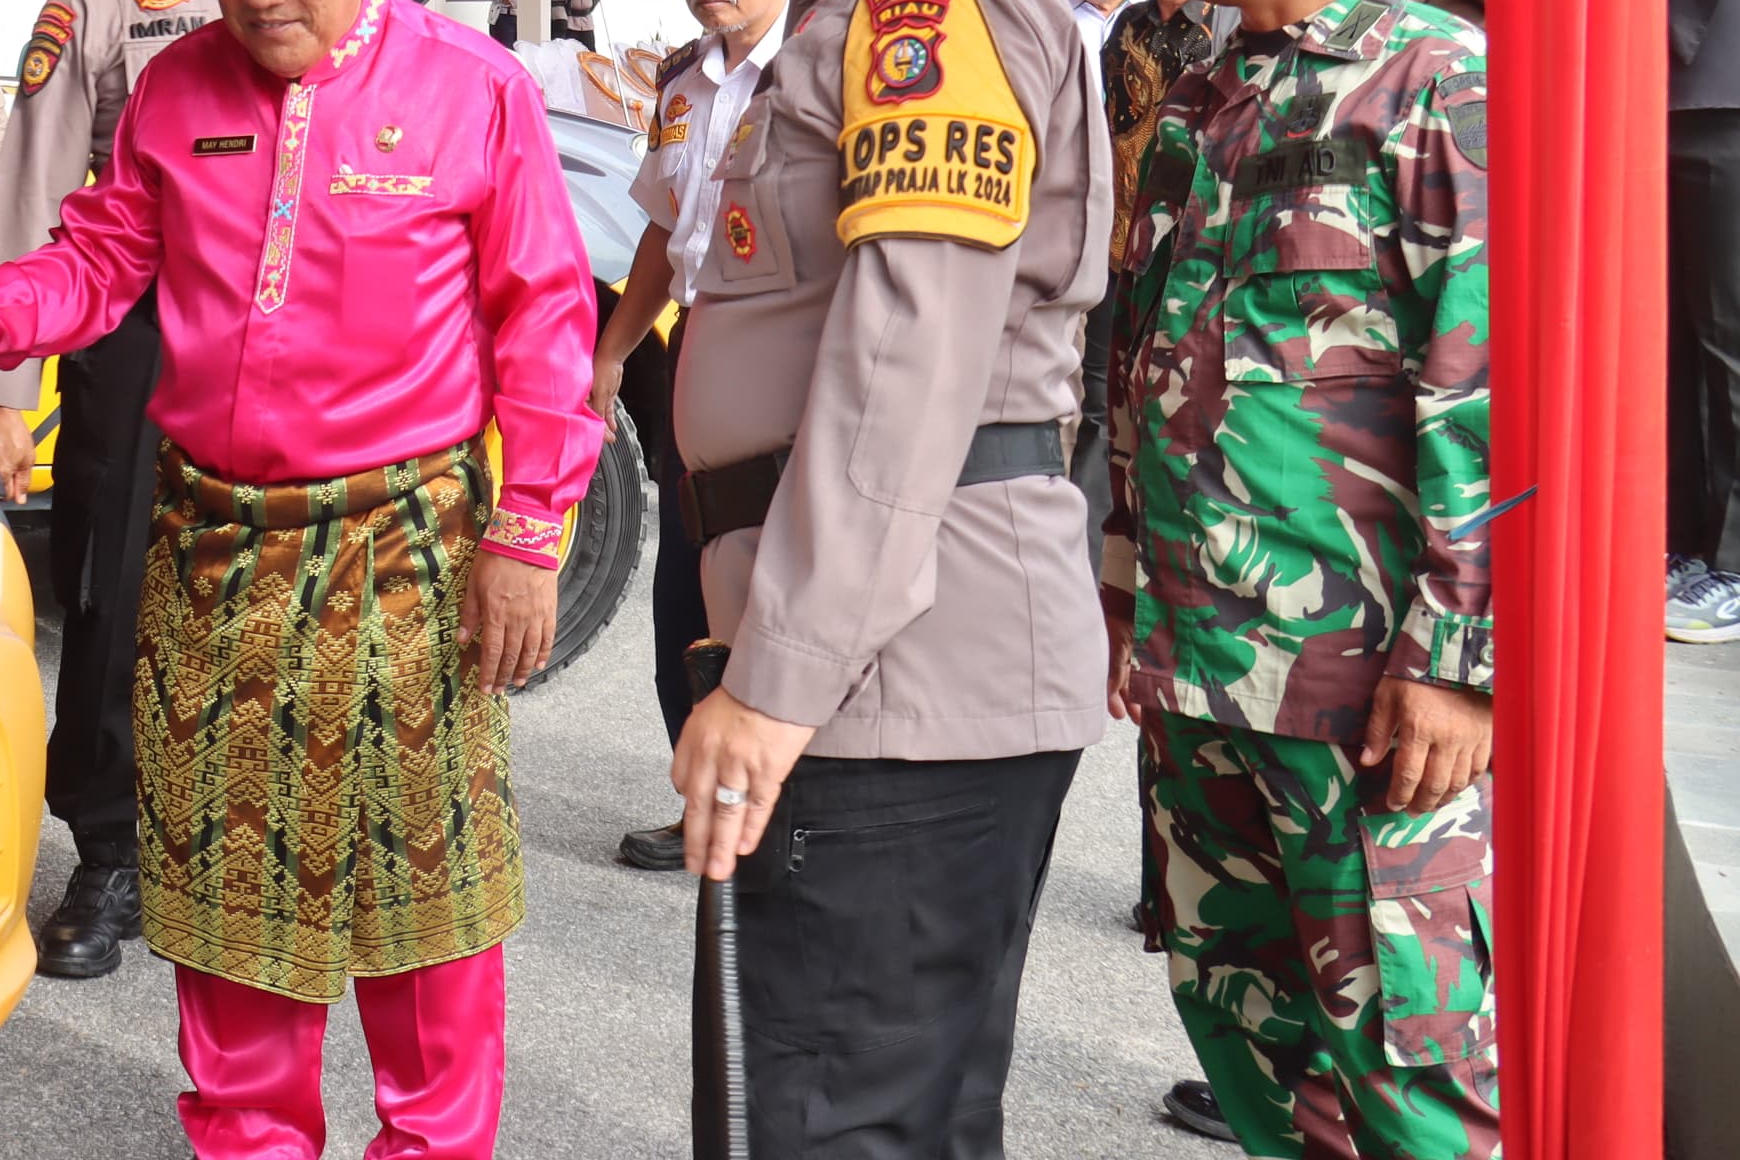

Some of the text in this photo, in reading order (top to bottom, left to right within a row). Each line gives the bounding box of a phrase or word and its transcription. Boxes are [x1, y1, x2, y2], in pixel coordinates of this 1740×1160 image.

[879, 1, 940, 22] RIAU
[129, 16, 206, 39] IMRAN
[201, 138, 248, 150] MAY HENDRI
[853, 118, 927, 172] OPS
[945, 120, 1016, 175] RES
[1256, 147, 1337, 185] TNI AD
[885, 166, 940, 195] PRAJA
[947, 167, 968, 196] LK
[973, 172, 1012, 207] 2024
